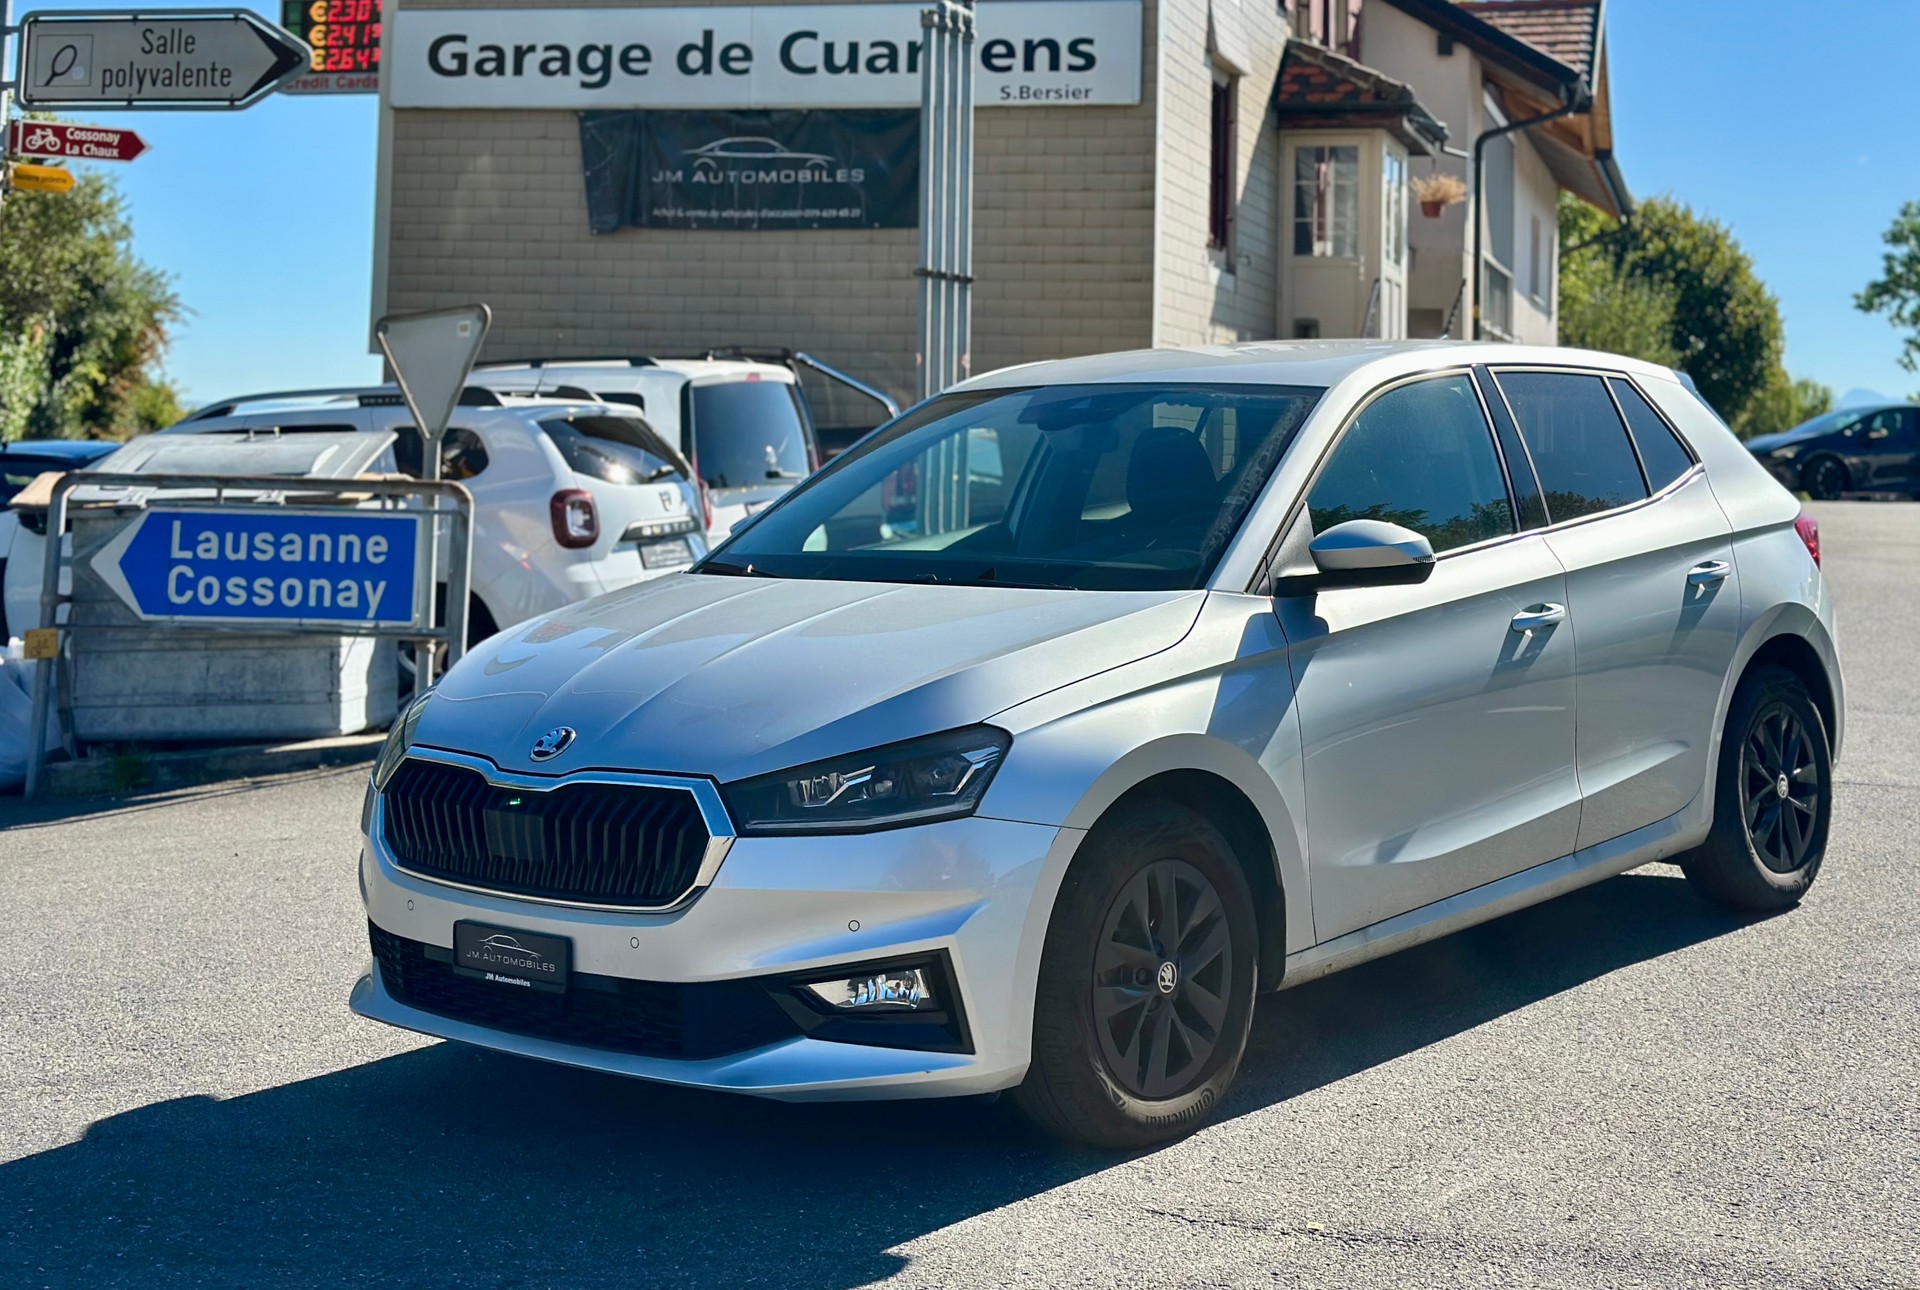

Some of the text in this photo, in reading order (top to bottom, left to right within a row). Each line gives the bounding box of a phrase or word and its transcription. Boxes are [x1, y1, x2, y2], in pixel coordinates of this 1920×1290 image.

[140, 28, 197, 55] Salle
[427, 29, 1097, 90] Garage de Cuarens
[101, 61, 232, 95] polyvalente
[1000, 84, 1094, 101] S.Bersier
[65, 127, 120, 146] Cossonay
[65, 143, 119, 158] La Chaux
[652, 168, 866, 185] JM AUTOMOBILES
[170, 520, 390, 565] Lausanne
[167, 565, 388, 619] Cossonay
[466, 950, 556, 973] JM AUTOMOBILES
[485, 972, 531, 988] JM Automobiles
